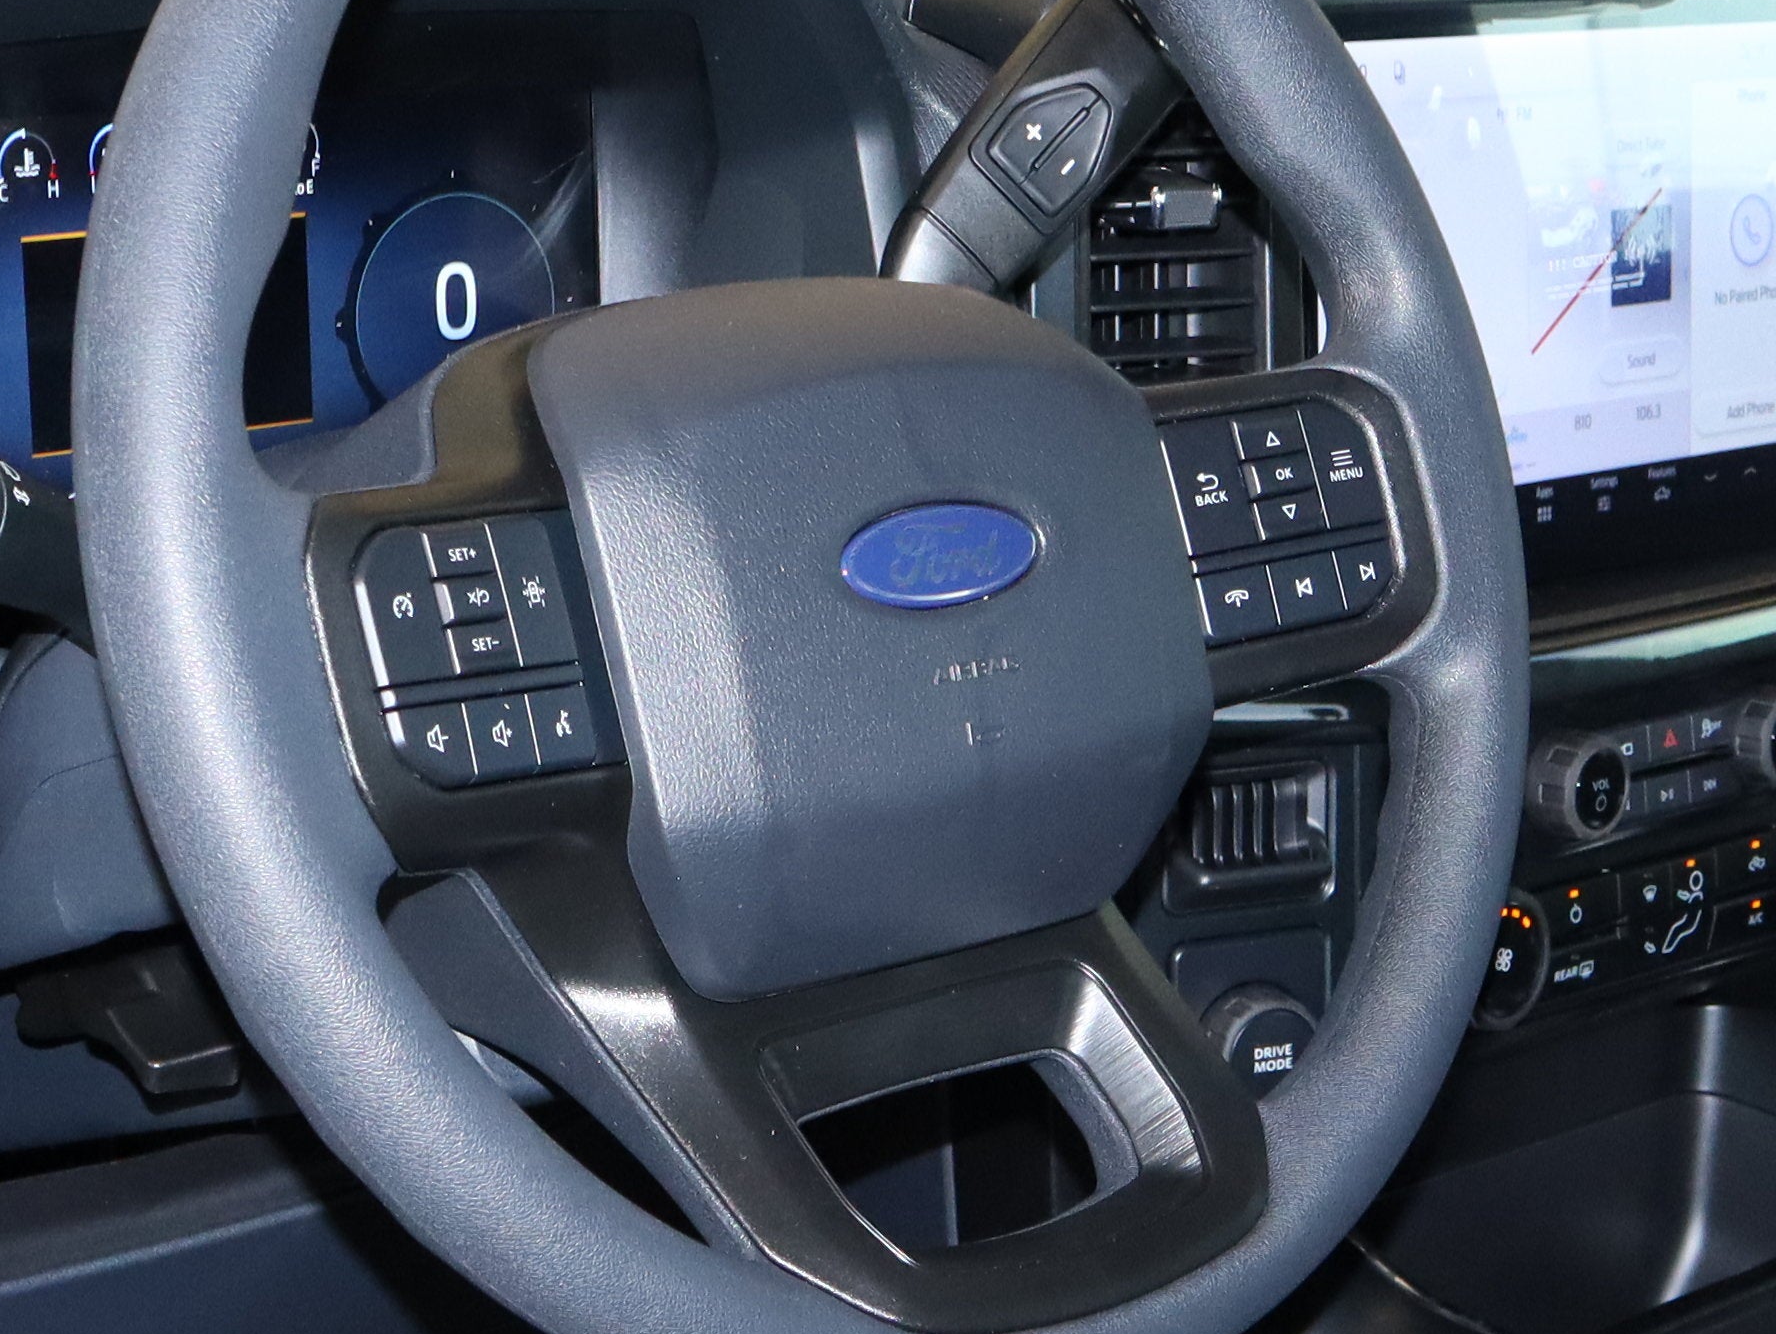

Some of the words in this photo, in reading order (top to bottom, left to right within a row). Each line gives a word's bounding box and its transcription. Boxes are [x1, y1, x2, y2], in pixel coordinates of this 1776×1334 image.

[47, 179, 60, 199] H
[433, 259, 480, 342] 0
[1714, 291, 1728, 305] No
[1729, 287, 1759, 303] Paired
[1627, 352, 1656, 369] Sound
[1636, 404, 1662, 421] 106.3
[1727, 405, 1745, 419] Add
[1746, 402, 1775, 417] Phone
[1275, 466, 1294, 481] OK
[1329, 466, 1364, 483] MENU
[1194, 490, 1229, 507] BACK
[448, 547, 477, 563] SET+
[889, 523, 1003, 586] Ford
[1592, 777, 1611, 792] VOL
[1553, 965, 1579, 984] REAR
[1253, 1042, 1294, 1060] DRIVE
[1253, 1057, 1294, 1074] MODE
